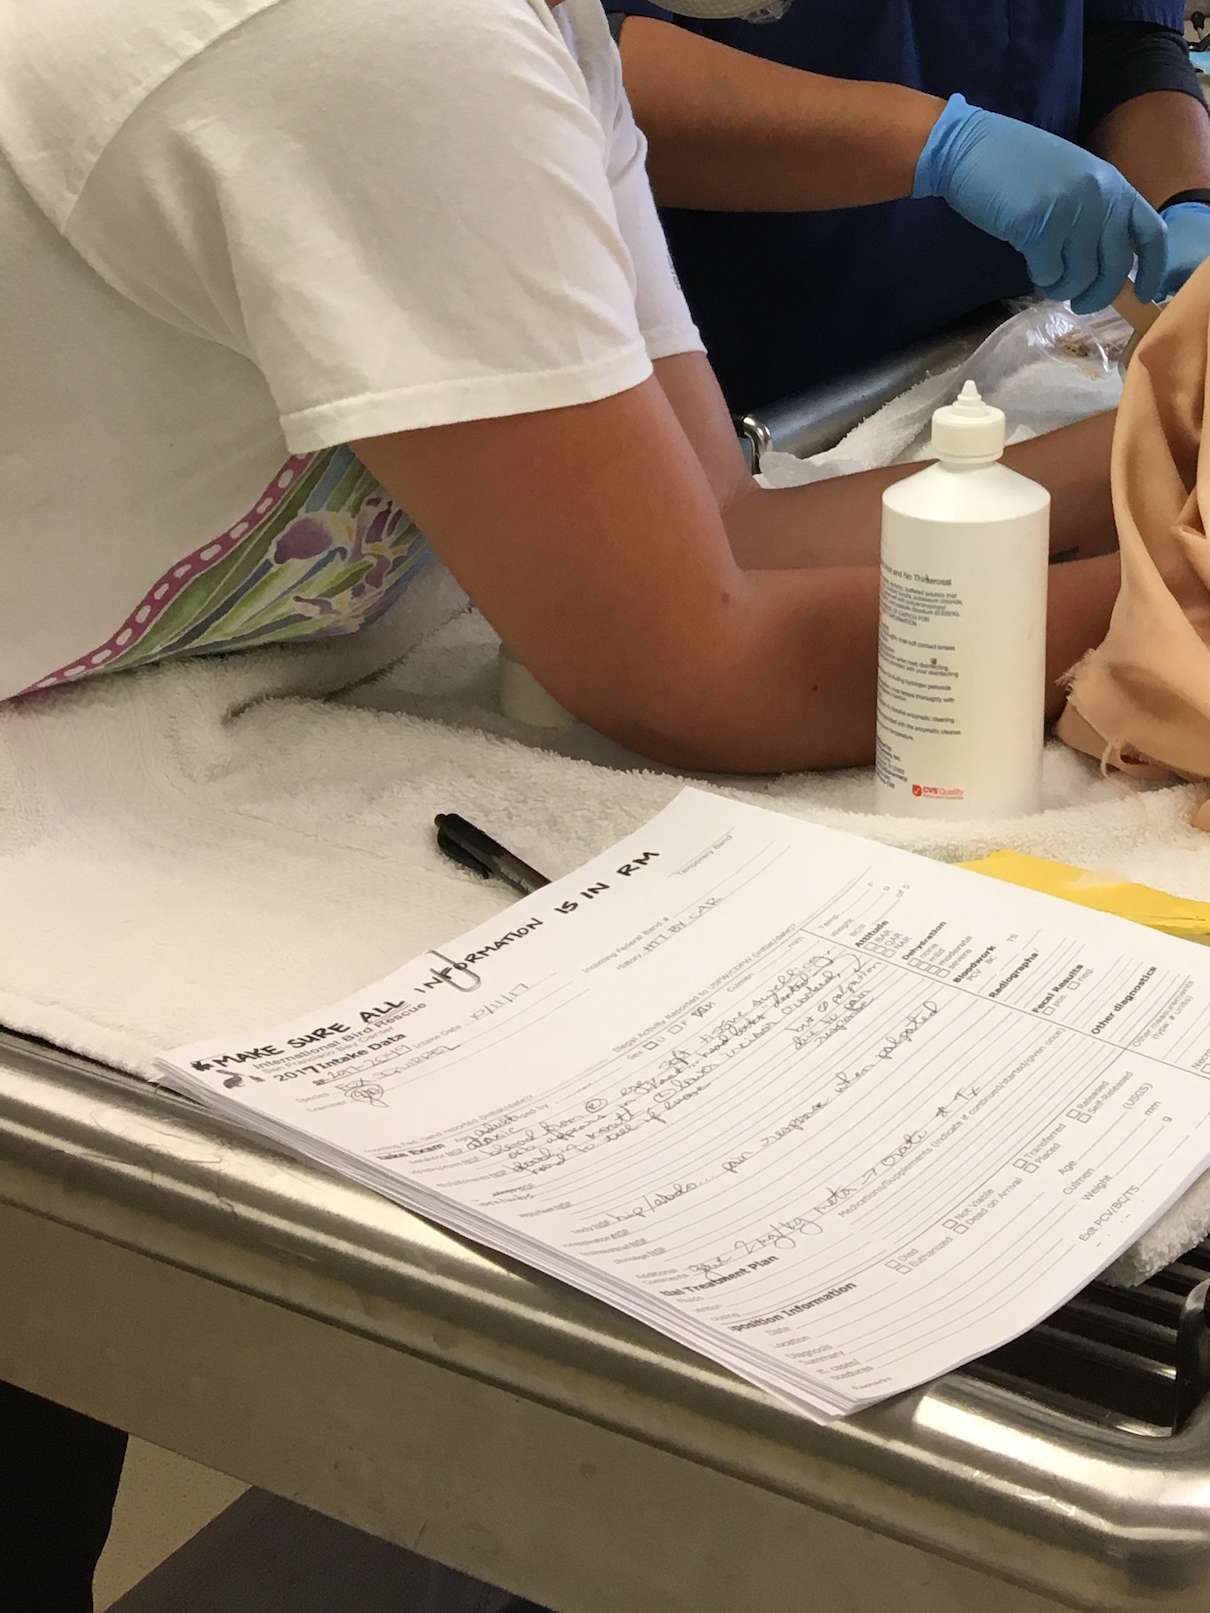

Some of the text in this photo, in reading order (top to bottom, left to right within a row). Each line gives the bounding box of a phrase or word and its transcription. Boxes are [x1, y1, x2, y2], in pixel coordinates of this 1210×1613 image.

[855, 921, 888, 947] Attitude
[902, 922, 946, 963] Dehydration
[213, 852, 659, 1072] MAKE SURE ALL INFORMATION IS IN RM
[953, 946, 995, 983] Bloodwork
[989, 953, 1038, 1002] Radiographs
[1032, 965, 1083, 1015] Fecal Results
[1091, 967, 1156, 1039] Other diagnostics
[253, 1003, 426, 1071] International Bird Rescue
[368, 1034, 405, 1050] Data
[1024, 1123, 1066, 1159] Transferred
[1077, 1081, 1109, 1109] Released
[1058, 1083, 1153, 1175] Age (USGS)
[1035, 1142, 1061, 1164] Placed
[1063, 1168, 1095, 1195] Culmen
[1082, 1175, 1113, 1200] Weight
[1078, 1185, 1139, 1241] Exit PCV/BC/TS
[684, 1256, 778, 1294] Treatment Plan
[782, 1283, 856, 1316] Information
